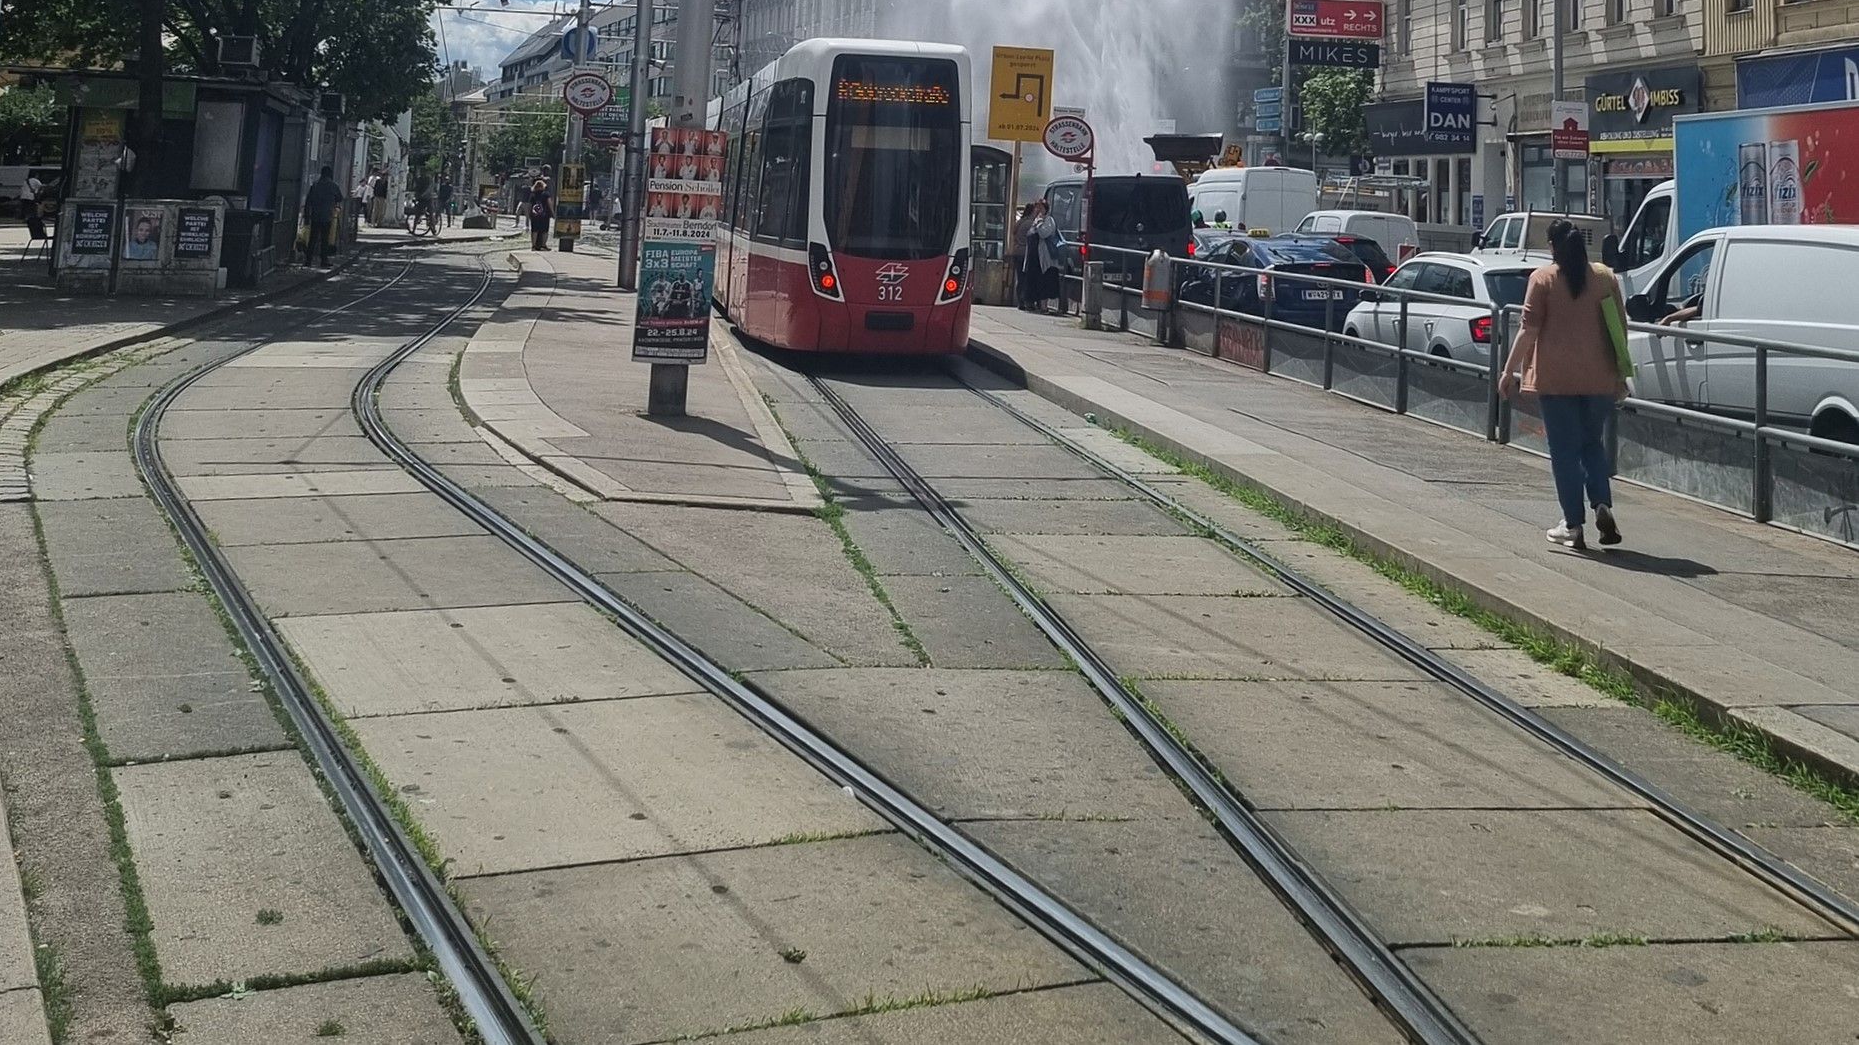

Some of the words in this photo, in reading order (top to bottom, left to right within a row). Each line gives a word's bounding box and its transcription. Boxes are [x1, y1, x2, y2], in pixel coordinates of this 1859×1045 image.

[1294, 15, 1316, 25] XXX
[1343, 23, 1378, 32] RECHTS
[1299, 45, 1368, 64] MIKES
[1431, 86, 1470, 94] KAMPFSPORT
[1440, 96, 1461, 104] CENTER
[1595, 93, 1626, 112] GÜRTEL
[1650, 89, 1680, 107] IMBISS
[1430, 112, 1471, 129] DAN
[1049, 120, 1089, 137] STRASSENBAHN
[1050, 139, 1086, 154] HALTESTELLE
[649, 180, 683, 191] Pension
[1742, 183, 1764, 199] fizix
[683, 220, 717, 231] Berndorf
[75, 233, 109, 241] KORRUPT?
[653, 228, 711, 238] 11.7.-11.8.2024
[645, 249, 669, 258] FIBA
[645, 258, 669, 269] 3x3
[878, 286, 903, 301] 312
